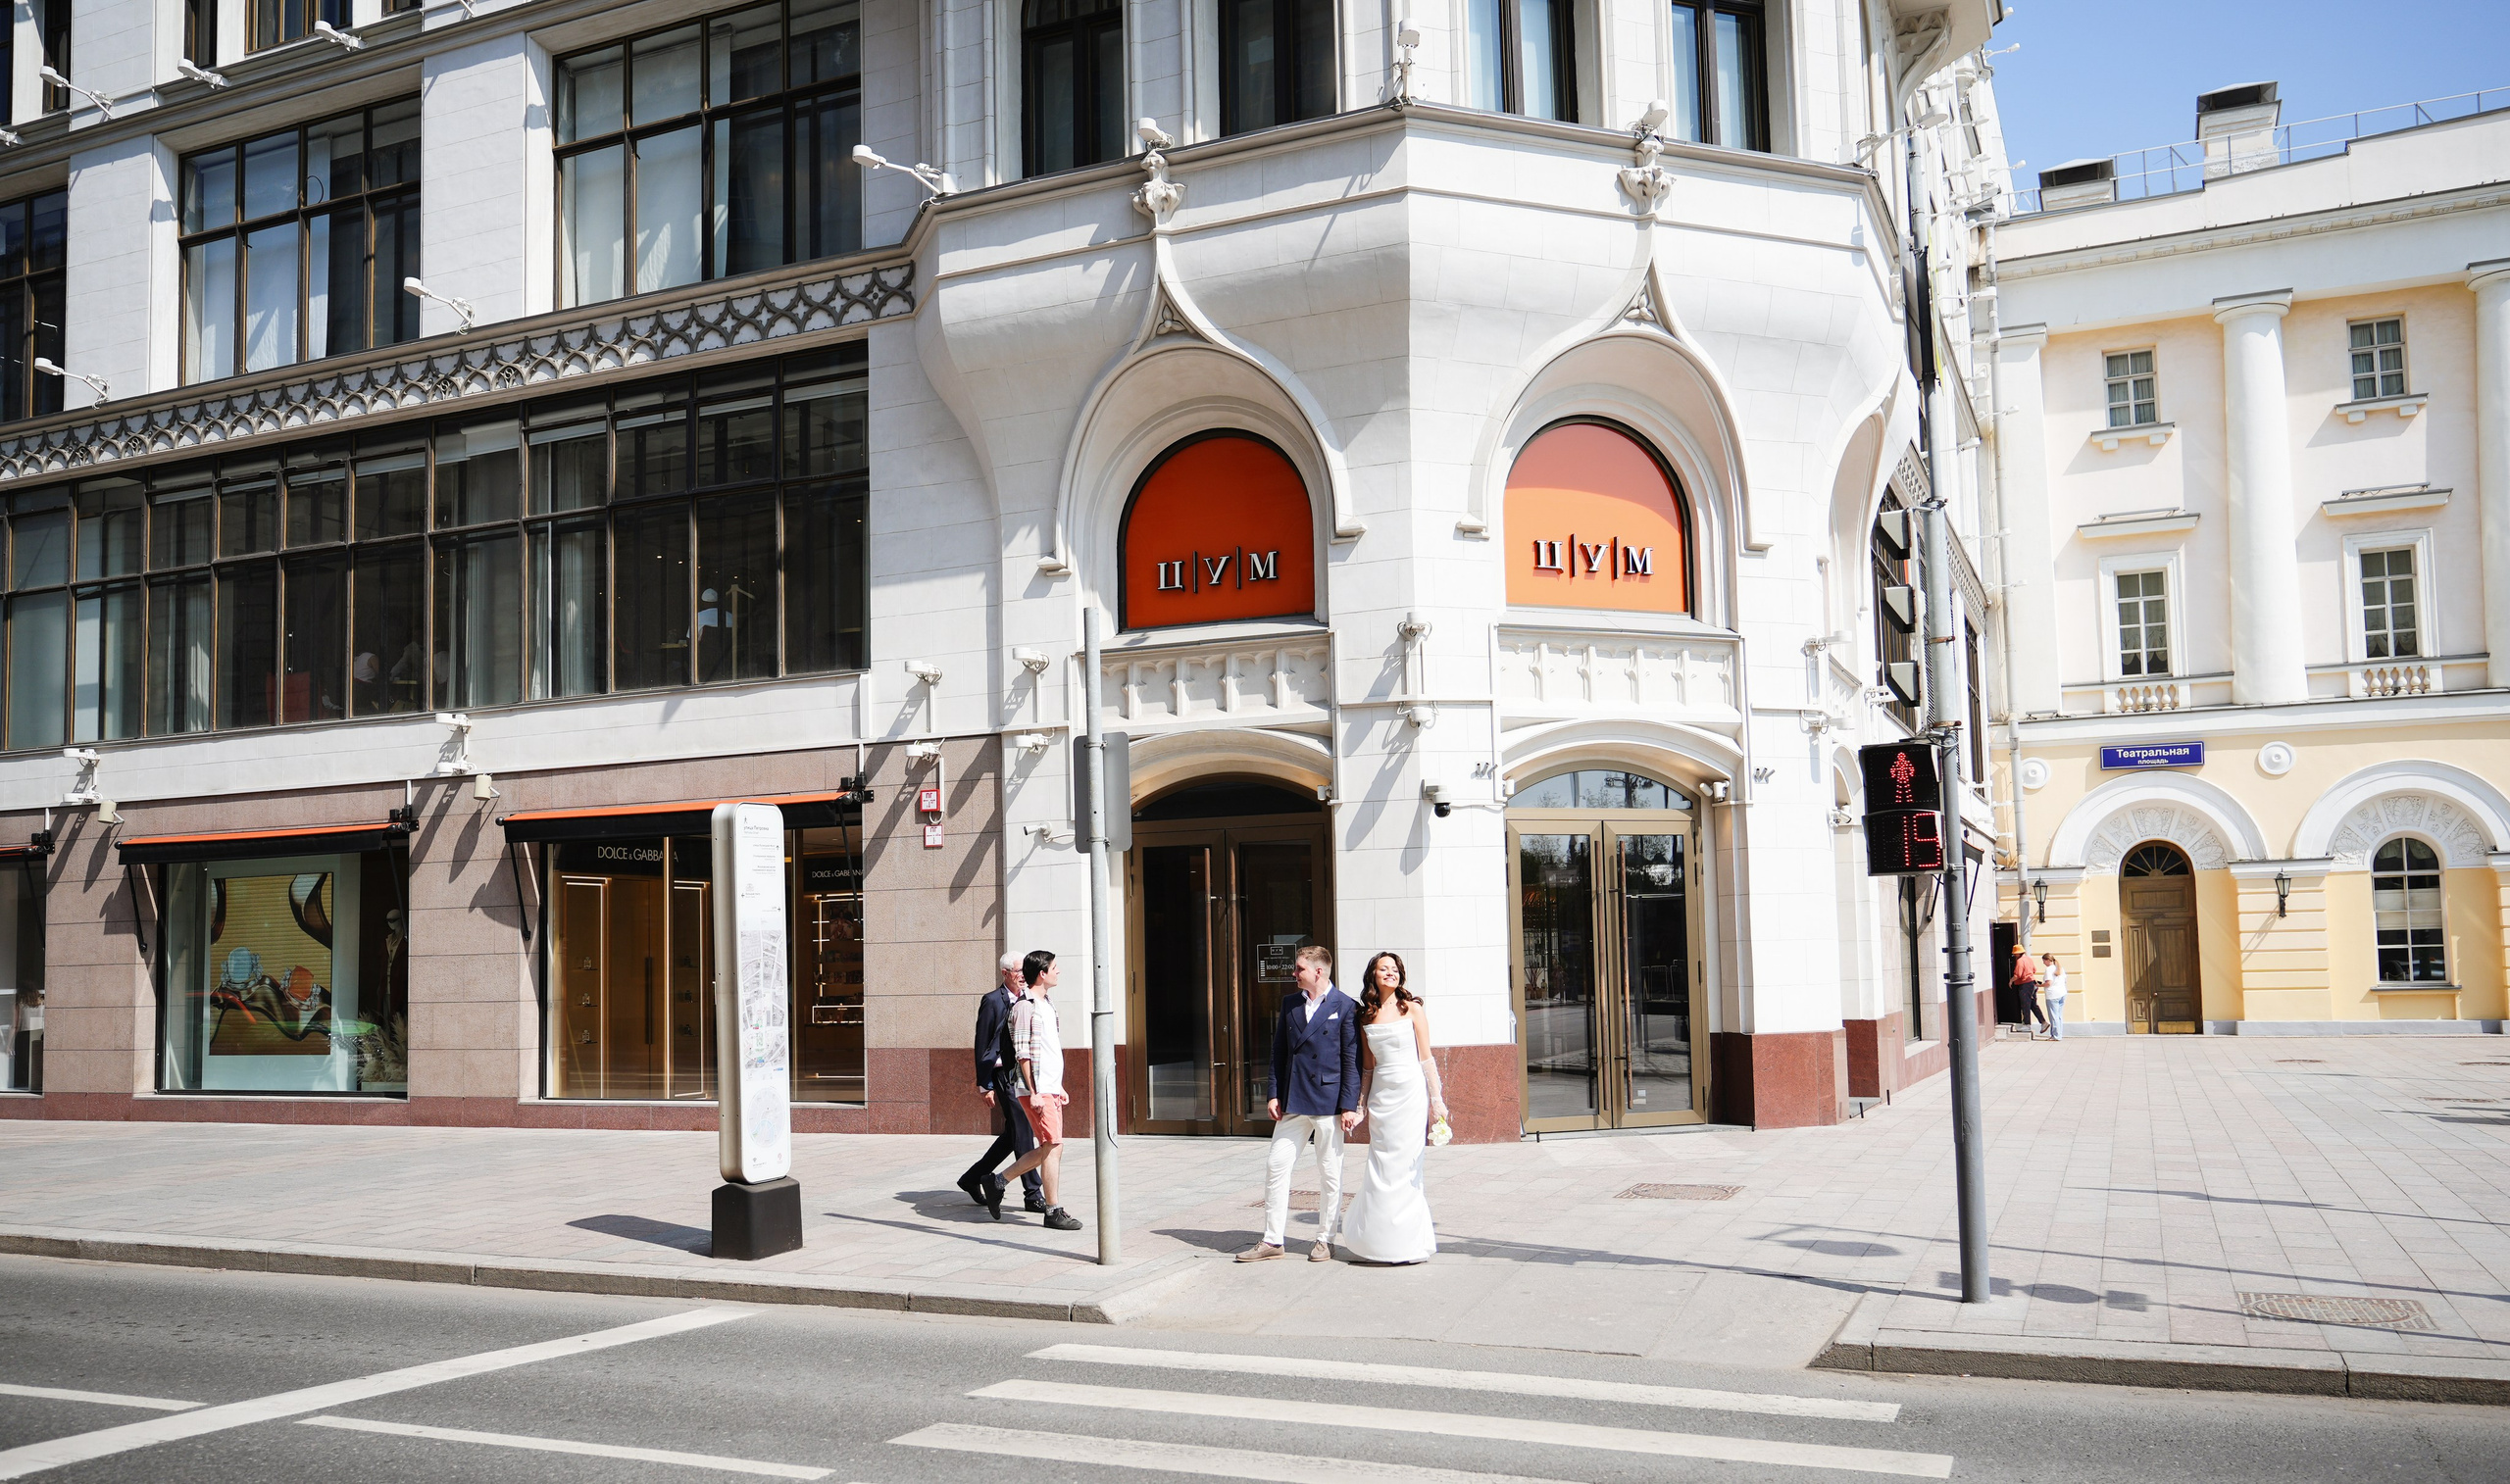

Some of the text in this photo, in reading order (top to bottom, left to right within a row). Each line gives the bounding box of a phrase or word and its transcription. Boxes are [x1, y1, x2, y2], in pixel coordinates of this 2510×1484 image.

[2116, 747, 2190, 759] Театральная
[597, 846, 628, 861] DOLCE
[633, 848, 679, 863] GABBAA
[812, 869, 831, 878] DOLCE
